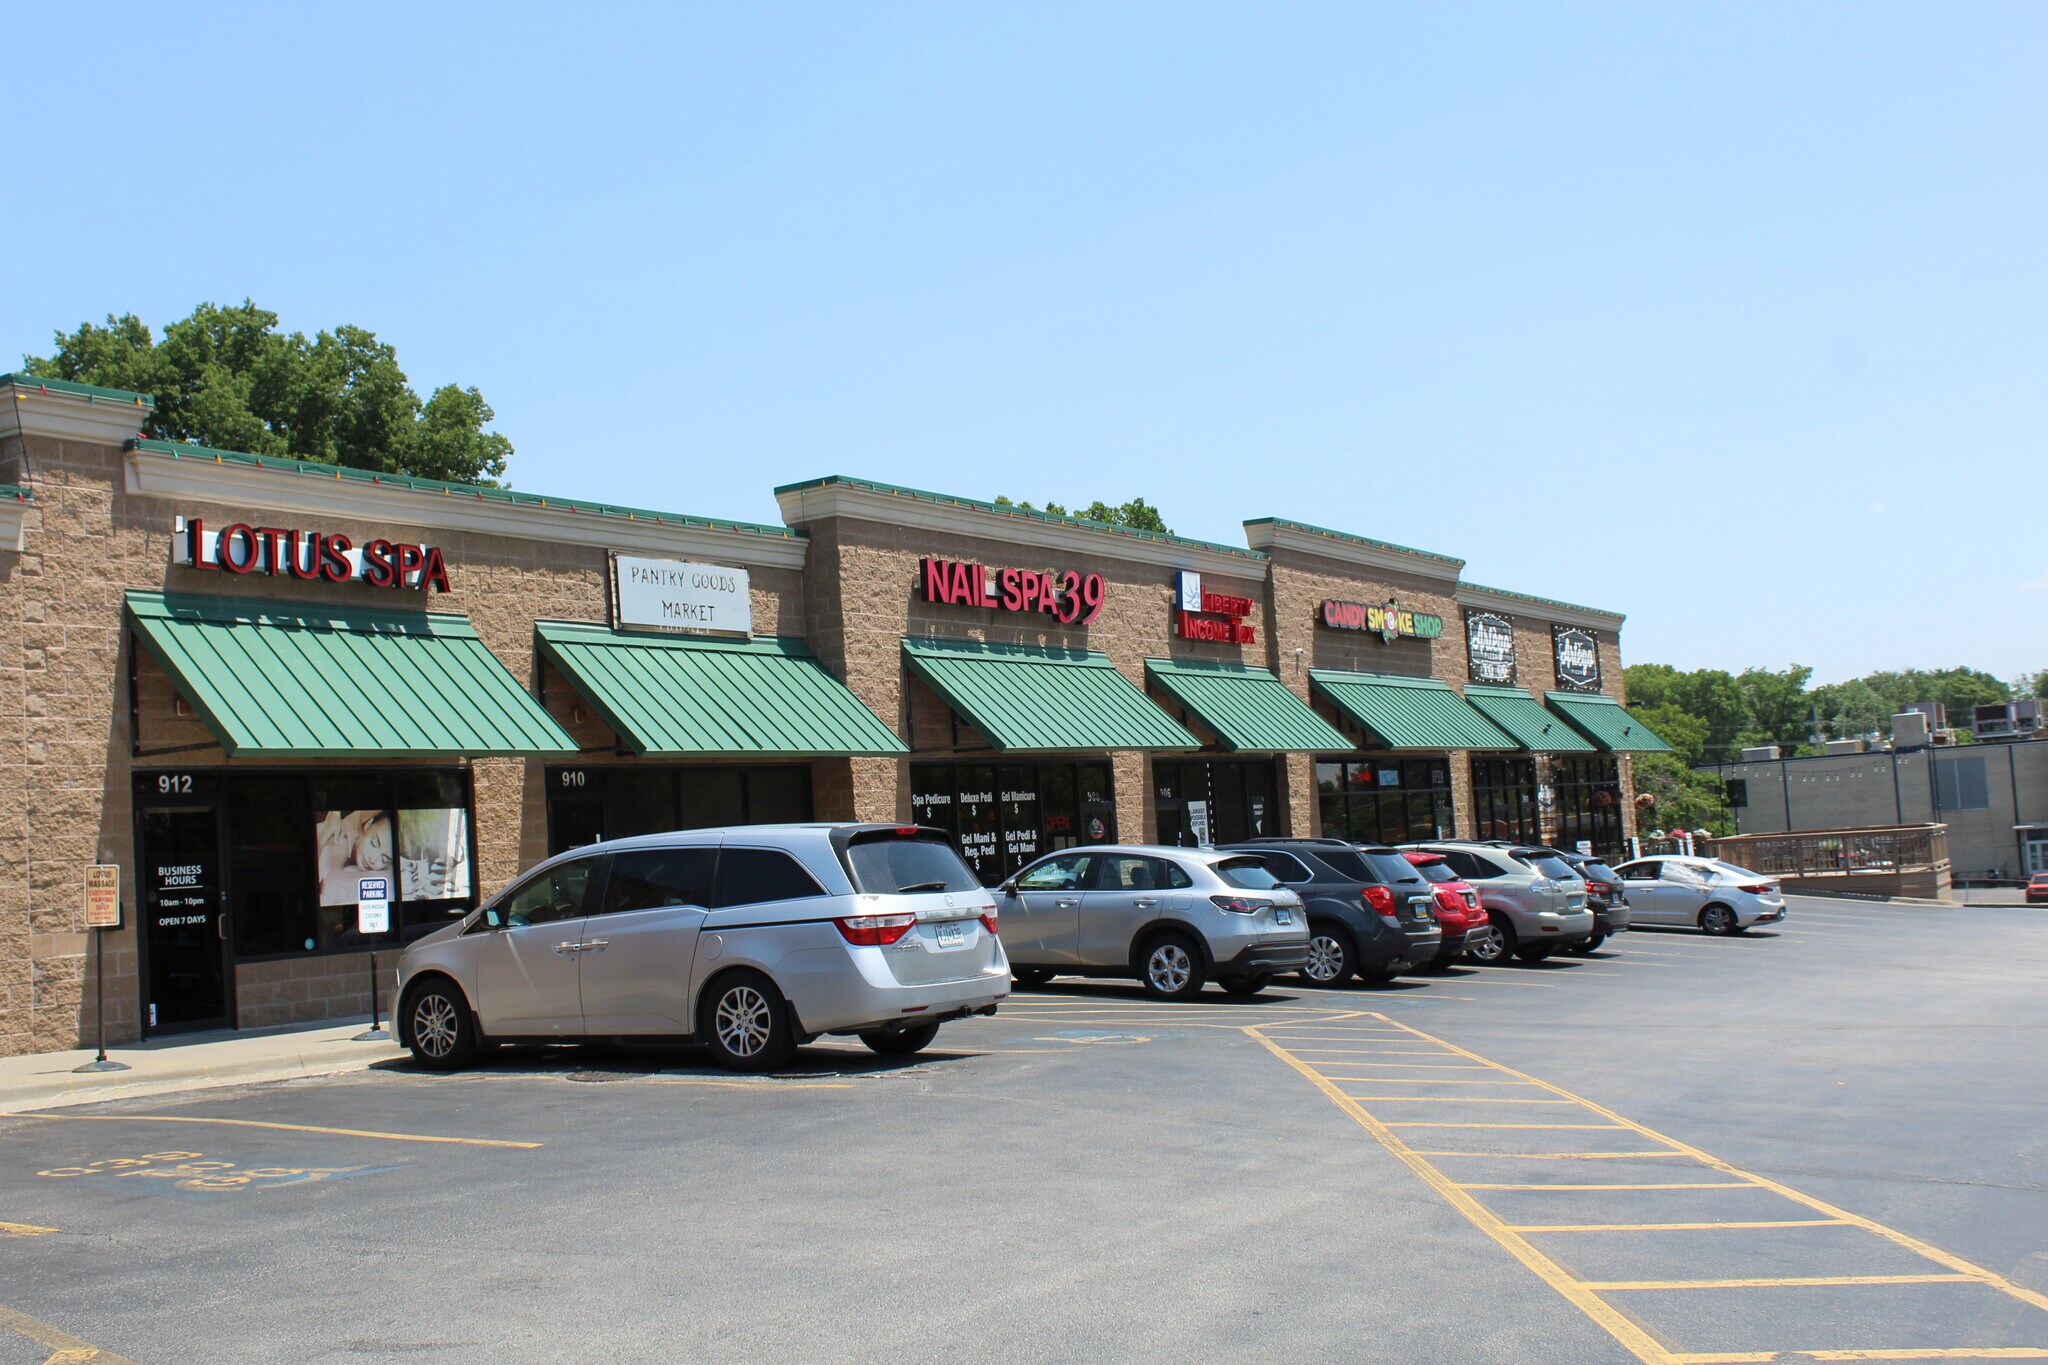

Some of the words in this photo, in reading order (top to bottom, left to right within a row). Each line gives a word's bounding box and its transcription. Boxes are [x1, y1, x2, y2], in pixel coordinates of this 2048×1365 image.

[188, 518, 352, 582] LOTUS
[362, 539, 450, 592] SPA
[631, 567, 685, 587] PANTRY
[692, 572, 736, 593] GOODS
[920, 558, 998, 608] NAIL
[997, 568, 1059, 615] SPA
[1057, 569, 1105, 624] 39
[1201, 585, 1253, 616] LIBERTY
[661, 600, 715, 621] MARKET
[1324, 600, 1367, 630] CANDY
[1413, 613, 1442, 638] SHOP
[1184, 611, 1231, 642] INCOME
[158, 775, 193, 793] 912
[562, 771, 586, 787] 910
[912, 794, 924, 807] Spa
[925, 793, 951, 805] Pedicure
[960, 792, 979, 803] Deluxe
[980, 792, 993, 802] Pedi
[1001, 791, 1011, 802] Gel
[1011, 790, 1036, 801] Manicure
[961, 833, 973, 845] Gel
[973, 832, 990, 844] Mani
[991, 832, 997, 842] &
[1005, 831, 1016, 841] Gel
[1017, 829, 1031, 840] Pedi
[1031, 829, 1037, 840] &
[964, 846, 980, 858] Reg.
[980, 844, 995, 856] Pedi
[1008, 843, 1019, 854] Gel
[1020, 842, 1036, 853] Mani
[158, 865, 202, 876] BUSINESS
[88, 879, 116, 888] MASSAGE
[165, 875, 197, 885] HOURS
[361, 880, 385, 890] RESERVED
[362, 890, 385, 899] PARKING
[160, 898, 180, 907] 10am
[184, 897, 204, 907] 10pm
[159, 917, 180, 926] OPEN
[180, 916, 186, 925] 7
[187, 914, 206, 924] DAYS
